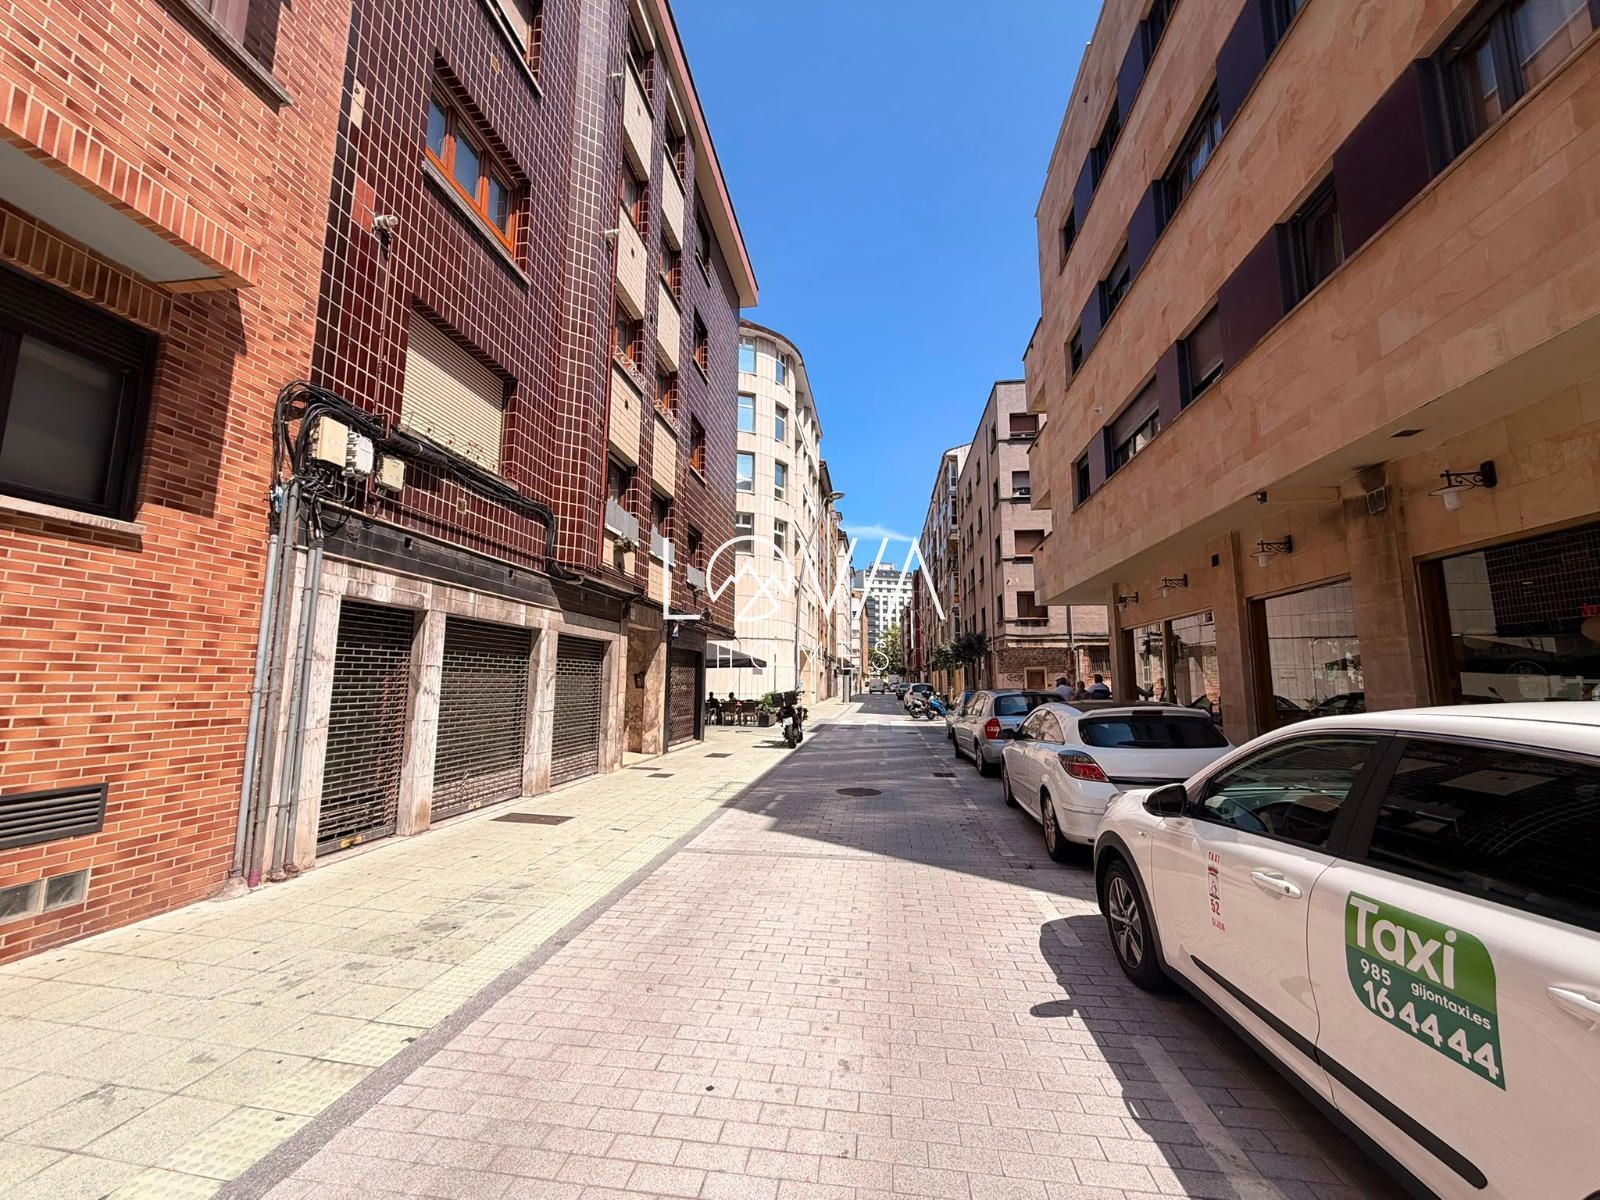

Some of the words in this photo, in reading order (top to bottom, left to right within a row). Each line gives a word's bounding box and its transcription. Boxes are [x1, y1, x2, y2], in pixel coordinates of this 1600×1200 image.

[1208, 851, 1221, 864] TAXI
[1210, 898, 1221, 916] 52
[1350, 896, 1457, 990] Taxi
[1360, 958, 1392, 986] 985
[1411, 982, 1491, 1030] gijontaxi.es
